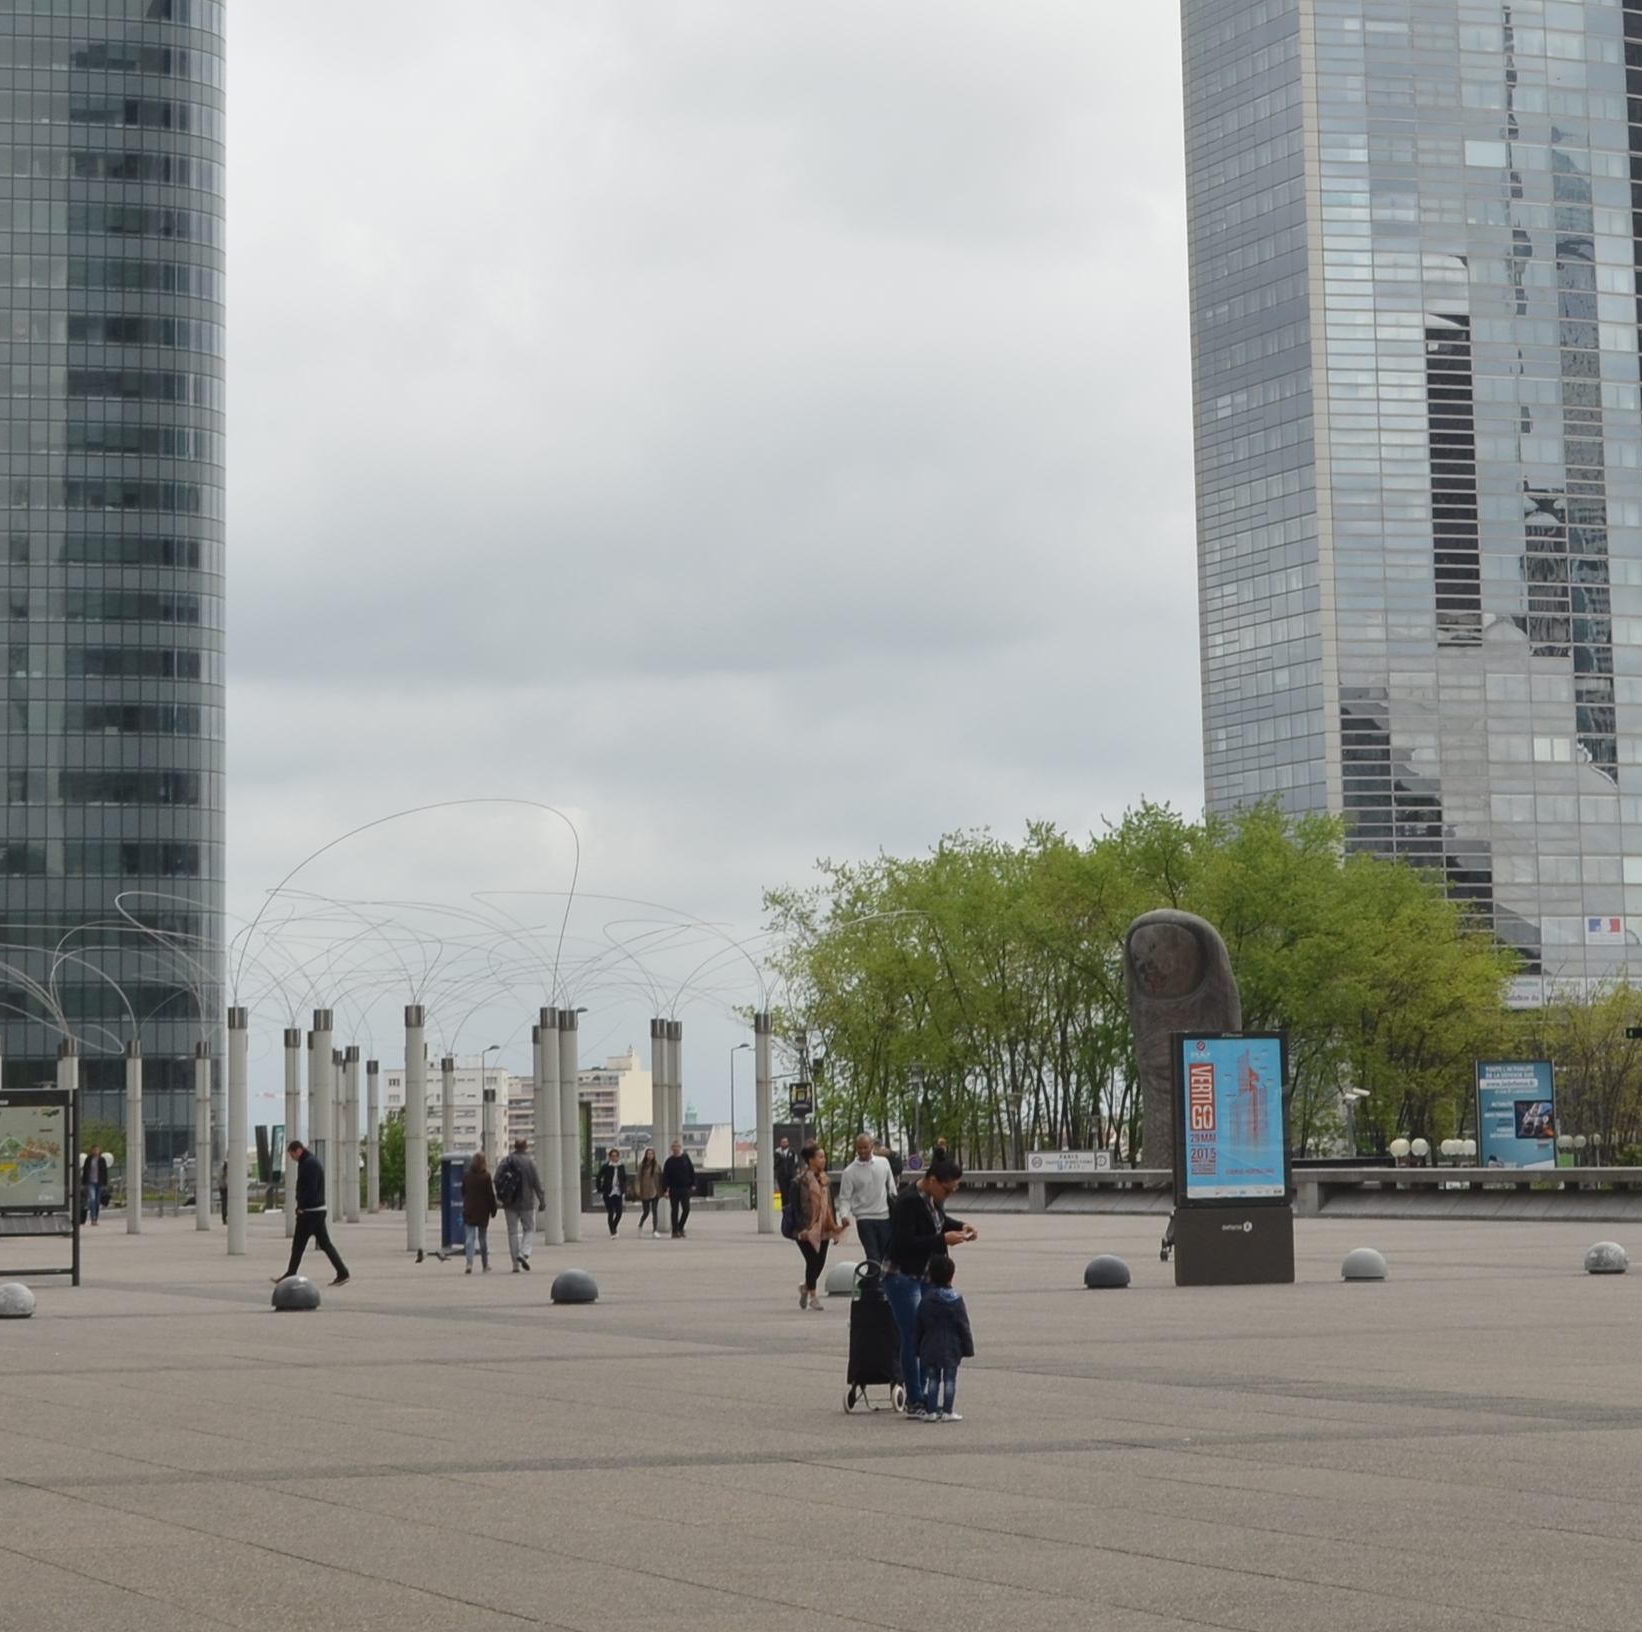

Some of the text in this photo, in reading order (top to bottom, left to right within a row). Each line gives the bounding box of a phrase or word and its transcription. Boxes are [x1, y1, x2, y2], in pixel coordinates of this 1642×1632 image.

[1191, 1066, 1213, 1104] VERTI
[1192, 1104, 1213, 1130] GO
[1190, 1133, 1216, 1143] 29 MAI
[1191, 1148, 1217, 1159] 2015
